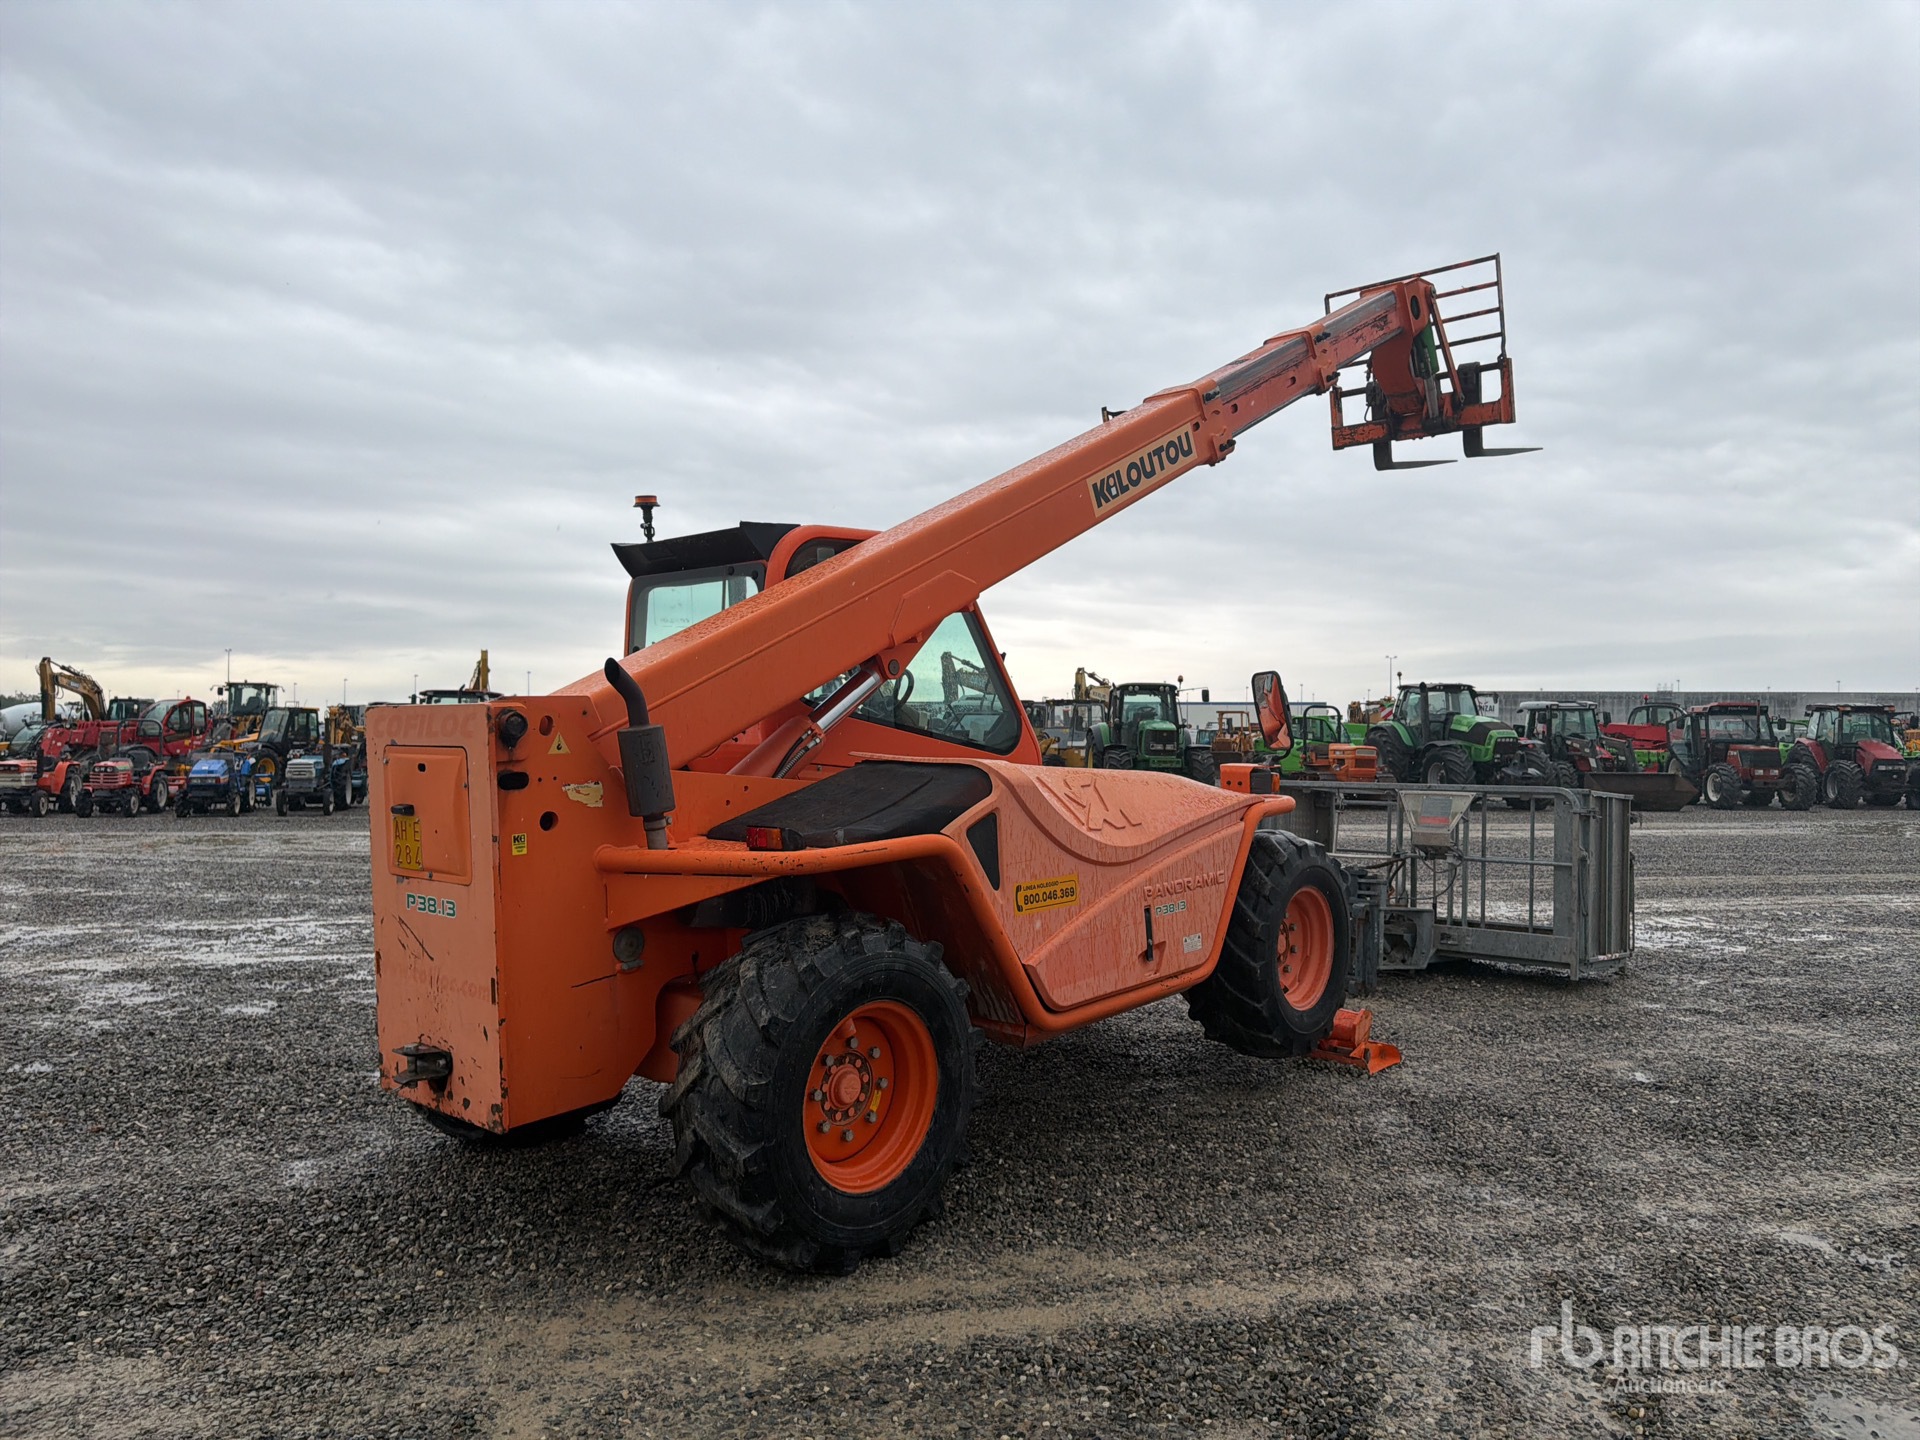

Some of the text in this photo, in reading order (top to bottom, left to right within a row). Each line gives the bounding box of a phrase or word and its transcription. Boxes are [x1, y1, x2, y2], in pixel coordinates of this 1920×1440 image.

[1024, 887, 1075, 905] 800.046.369
[1143, 870, 1225, 901] PANORAMIC
[406, 892, 456, 918] P38.13
[1155, 900, 1187, 917] P38.13
